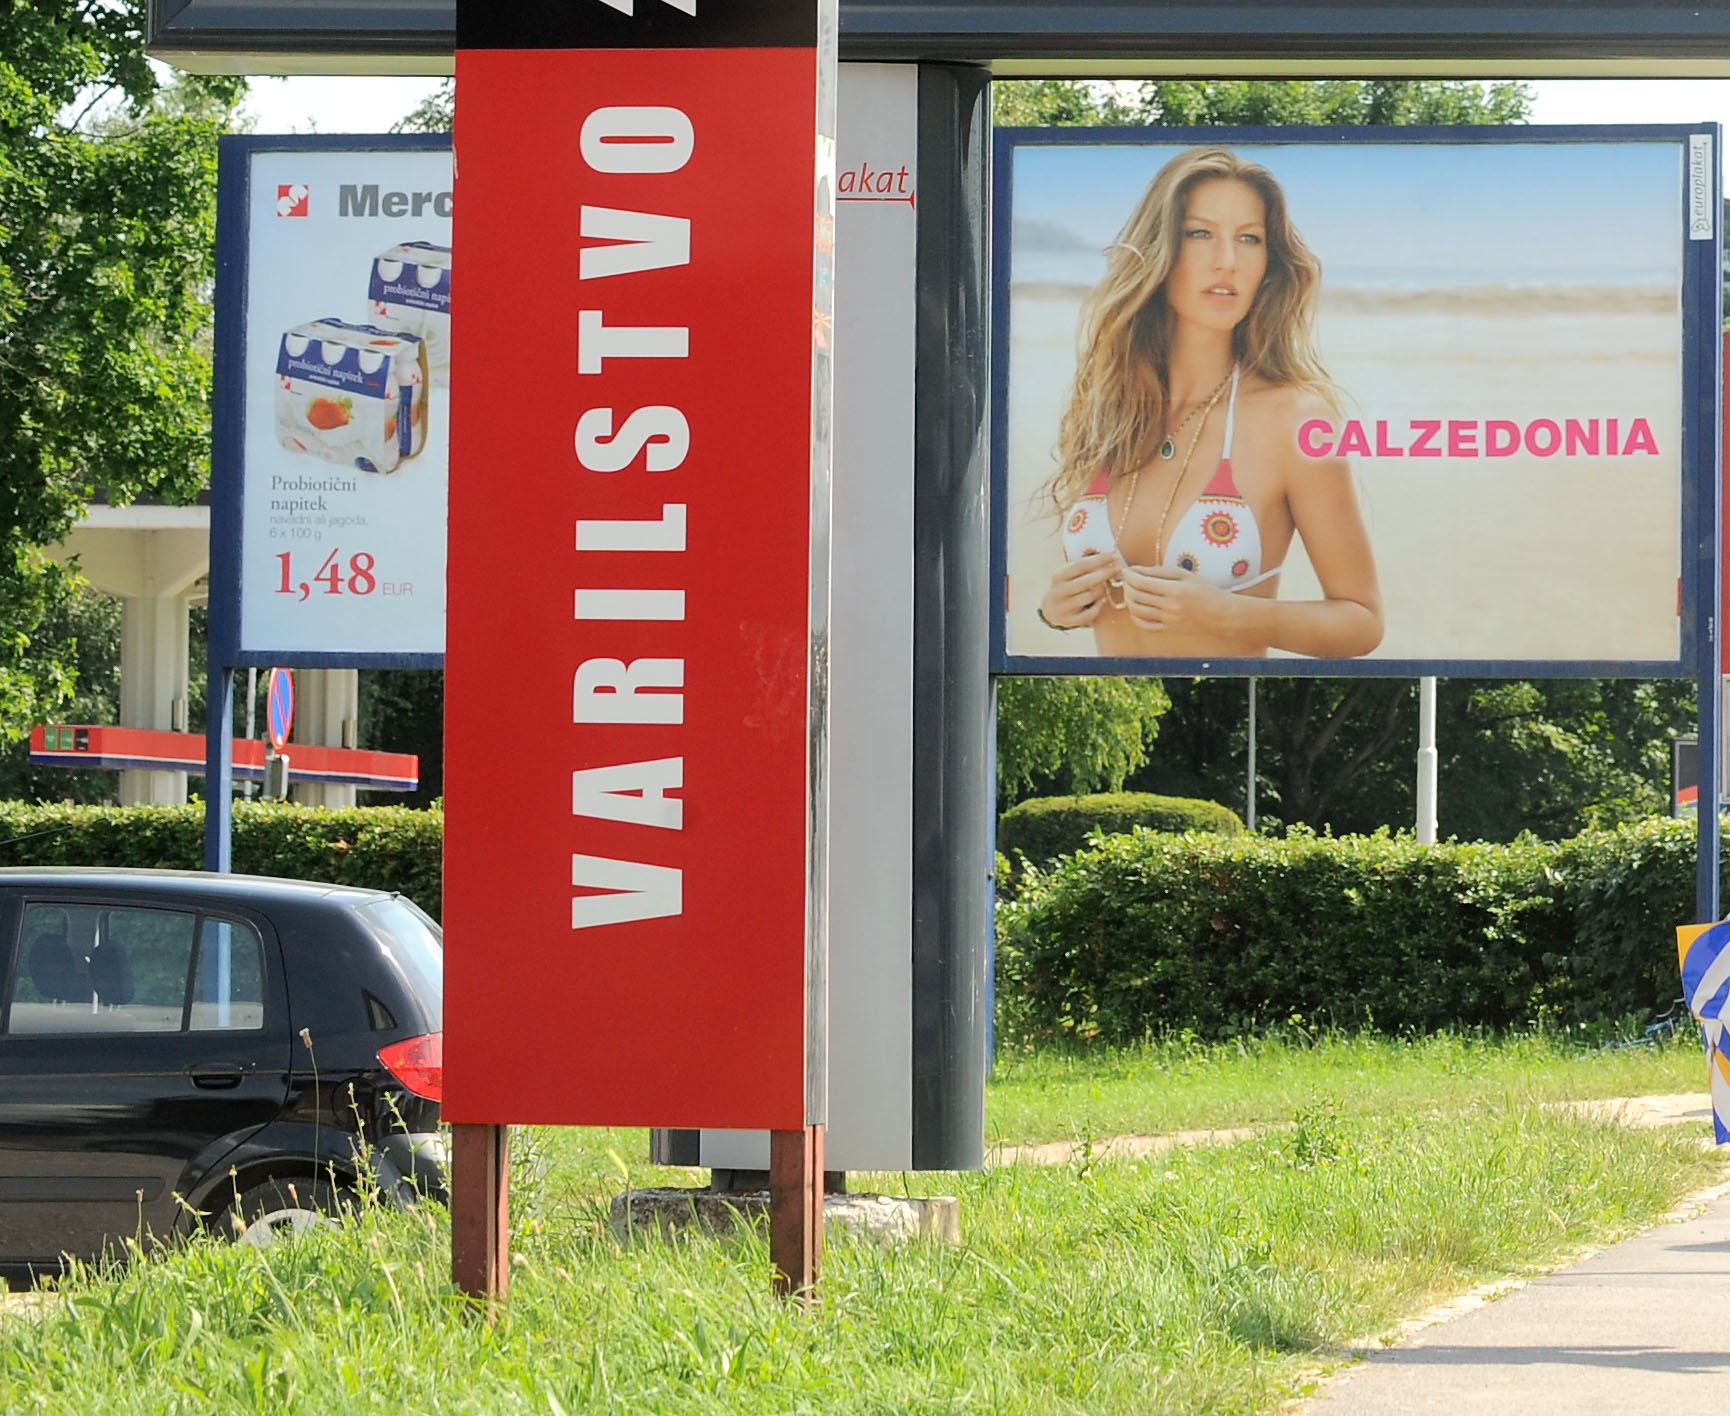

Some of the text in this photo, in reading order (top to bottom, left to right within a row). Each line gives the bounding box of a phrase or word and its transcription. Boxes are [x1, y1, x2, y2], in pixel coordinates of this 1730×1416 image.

[838, 162, 909, 193] akat
[339, 184, 453, 217] Merc
[1299, 418, 1659, 459] CALZEDONIA
[271, 475, 356, 492] Probiotični
[271, 495, 328, 515] napitek
[571, 105, 695, 930] VARILSTVO
[291, 528, 311, 539] 100
[275, 548, 413, 602] 1,48 EUR
